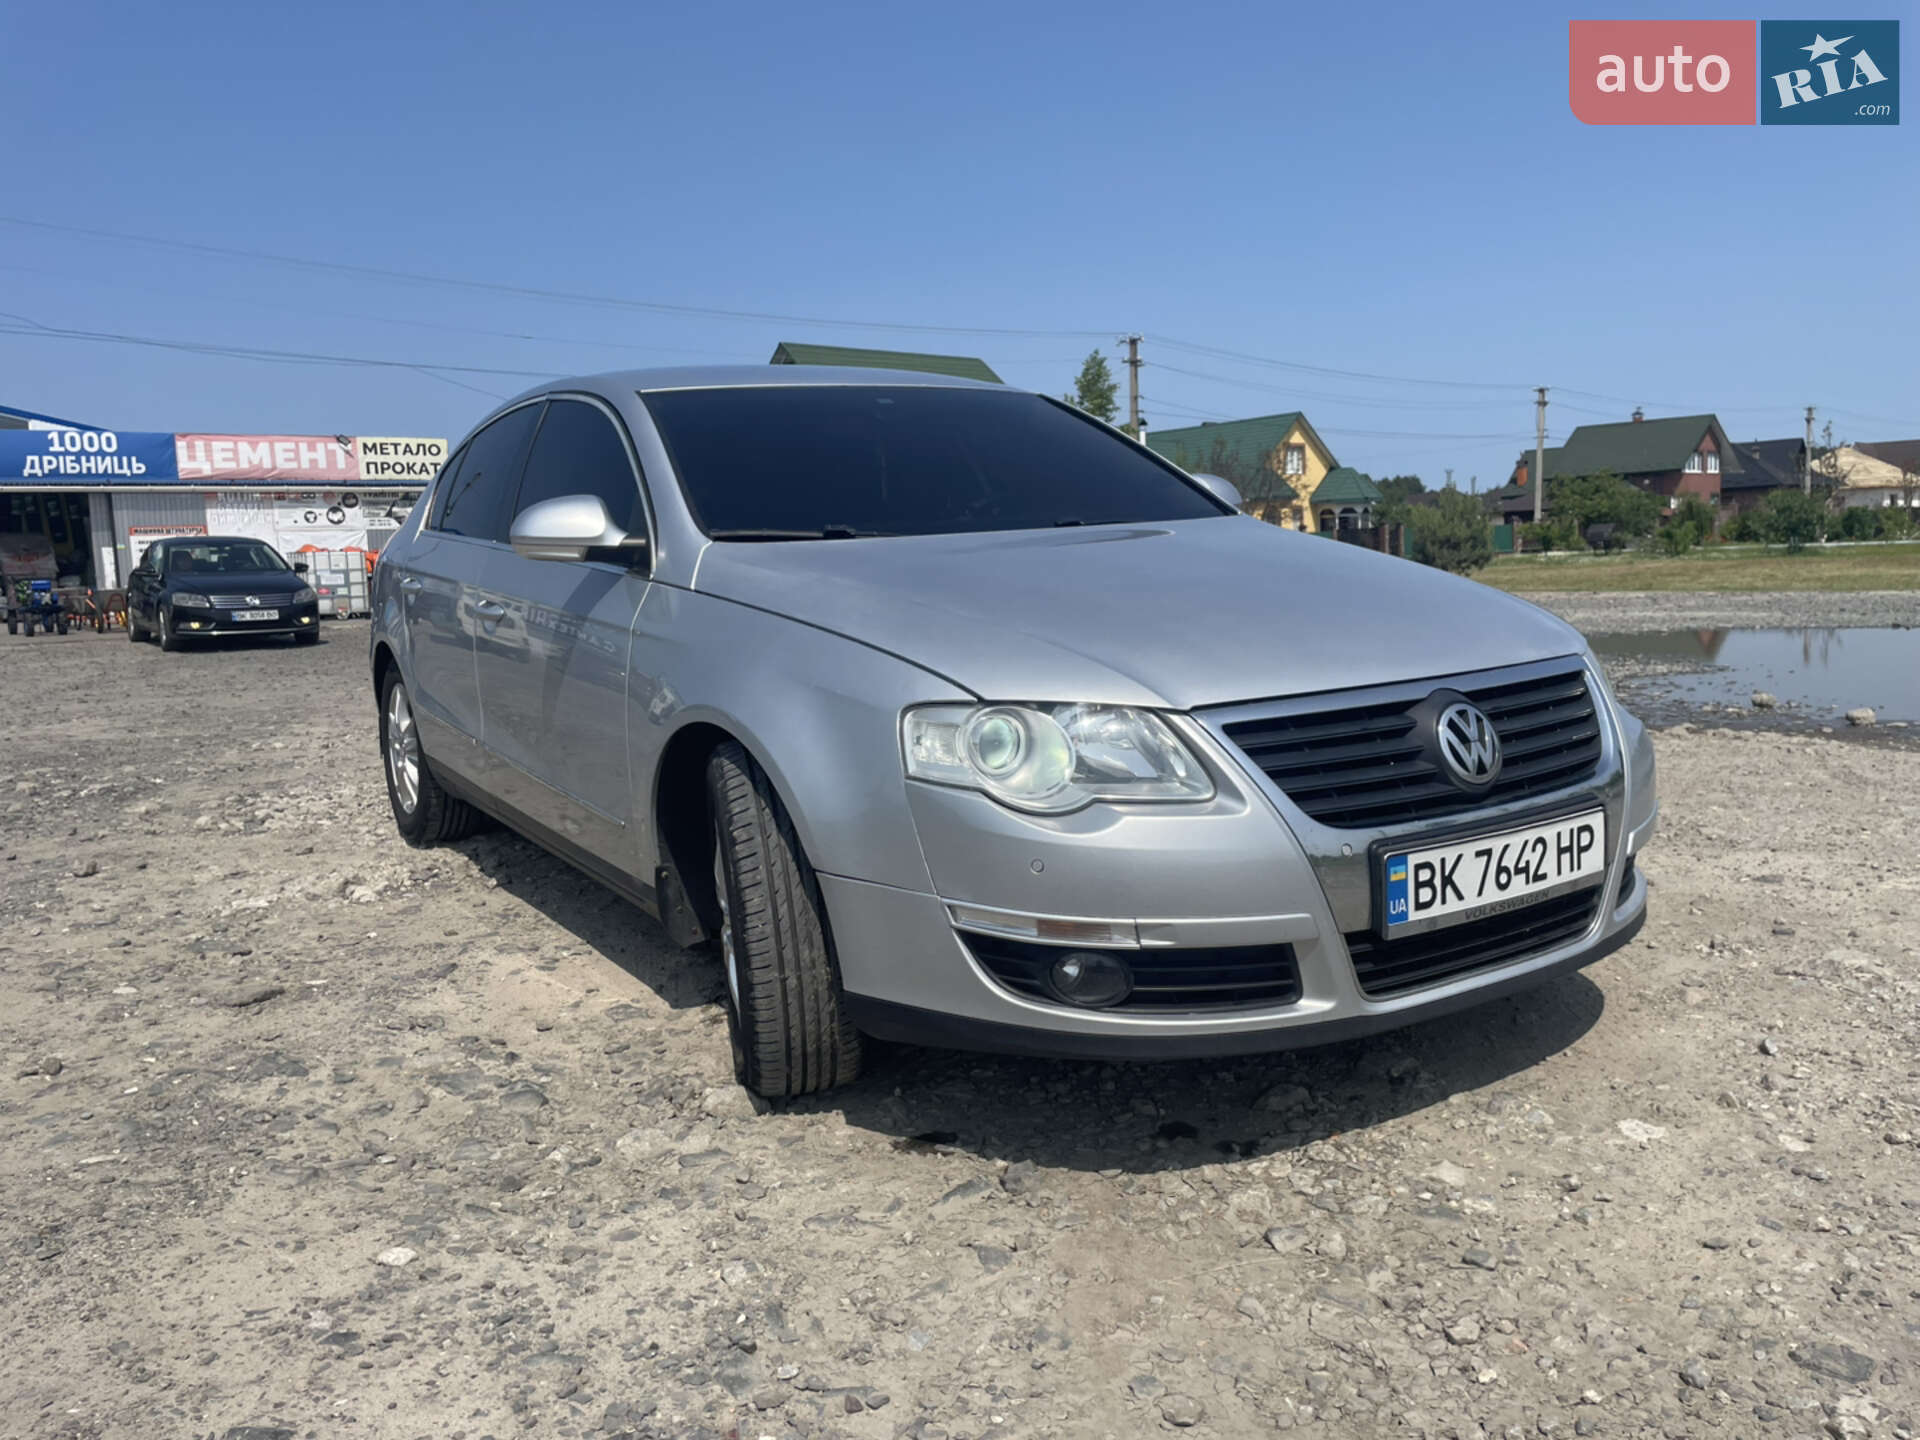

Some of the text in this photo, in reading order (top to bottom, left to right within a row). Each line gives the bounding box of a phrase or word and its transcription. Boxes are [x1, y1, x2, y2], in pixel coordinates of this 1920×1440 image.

[47, 431, 118, 453] 1000
[362, 442, 441, 456] МЕТАЛО
[23, 455, 147, 477] ДРІБНИЦЬ
[176, 440, 353, 475] ЦЕМЕНТ
[365, 461, 441, 476] ПРОКАТ
[1413, 824, 1595, 911] BK 7642 HP
[1390, 898, 1407, 915] UA
[1465, 890, 1550, 920] VOLKSWAGEN
